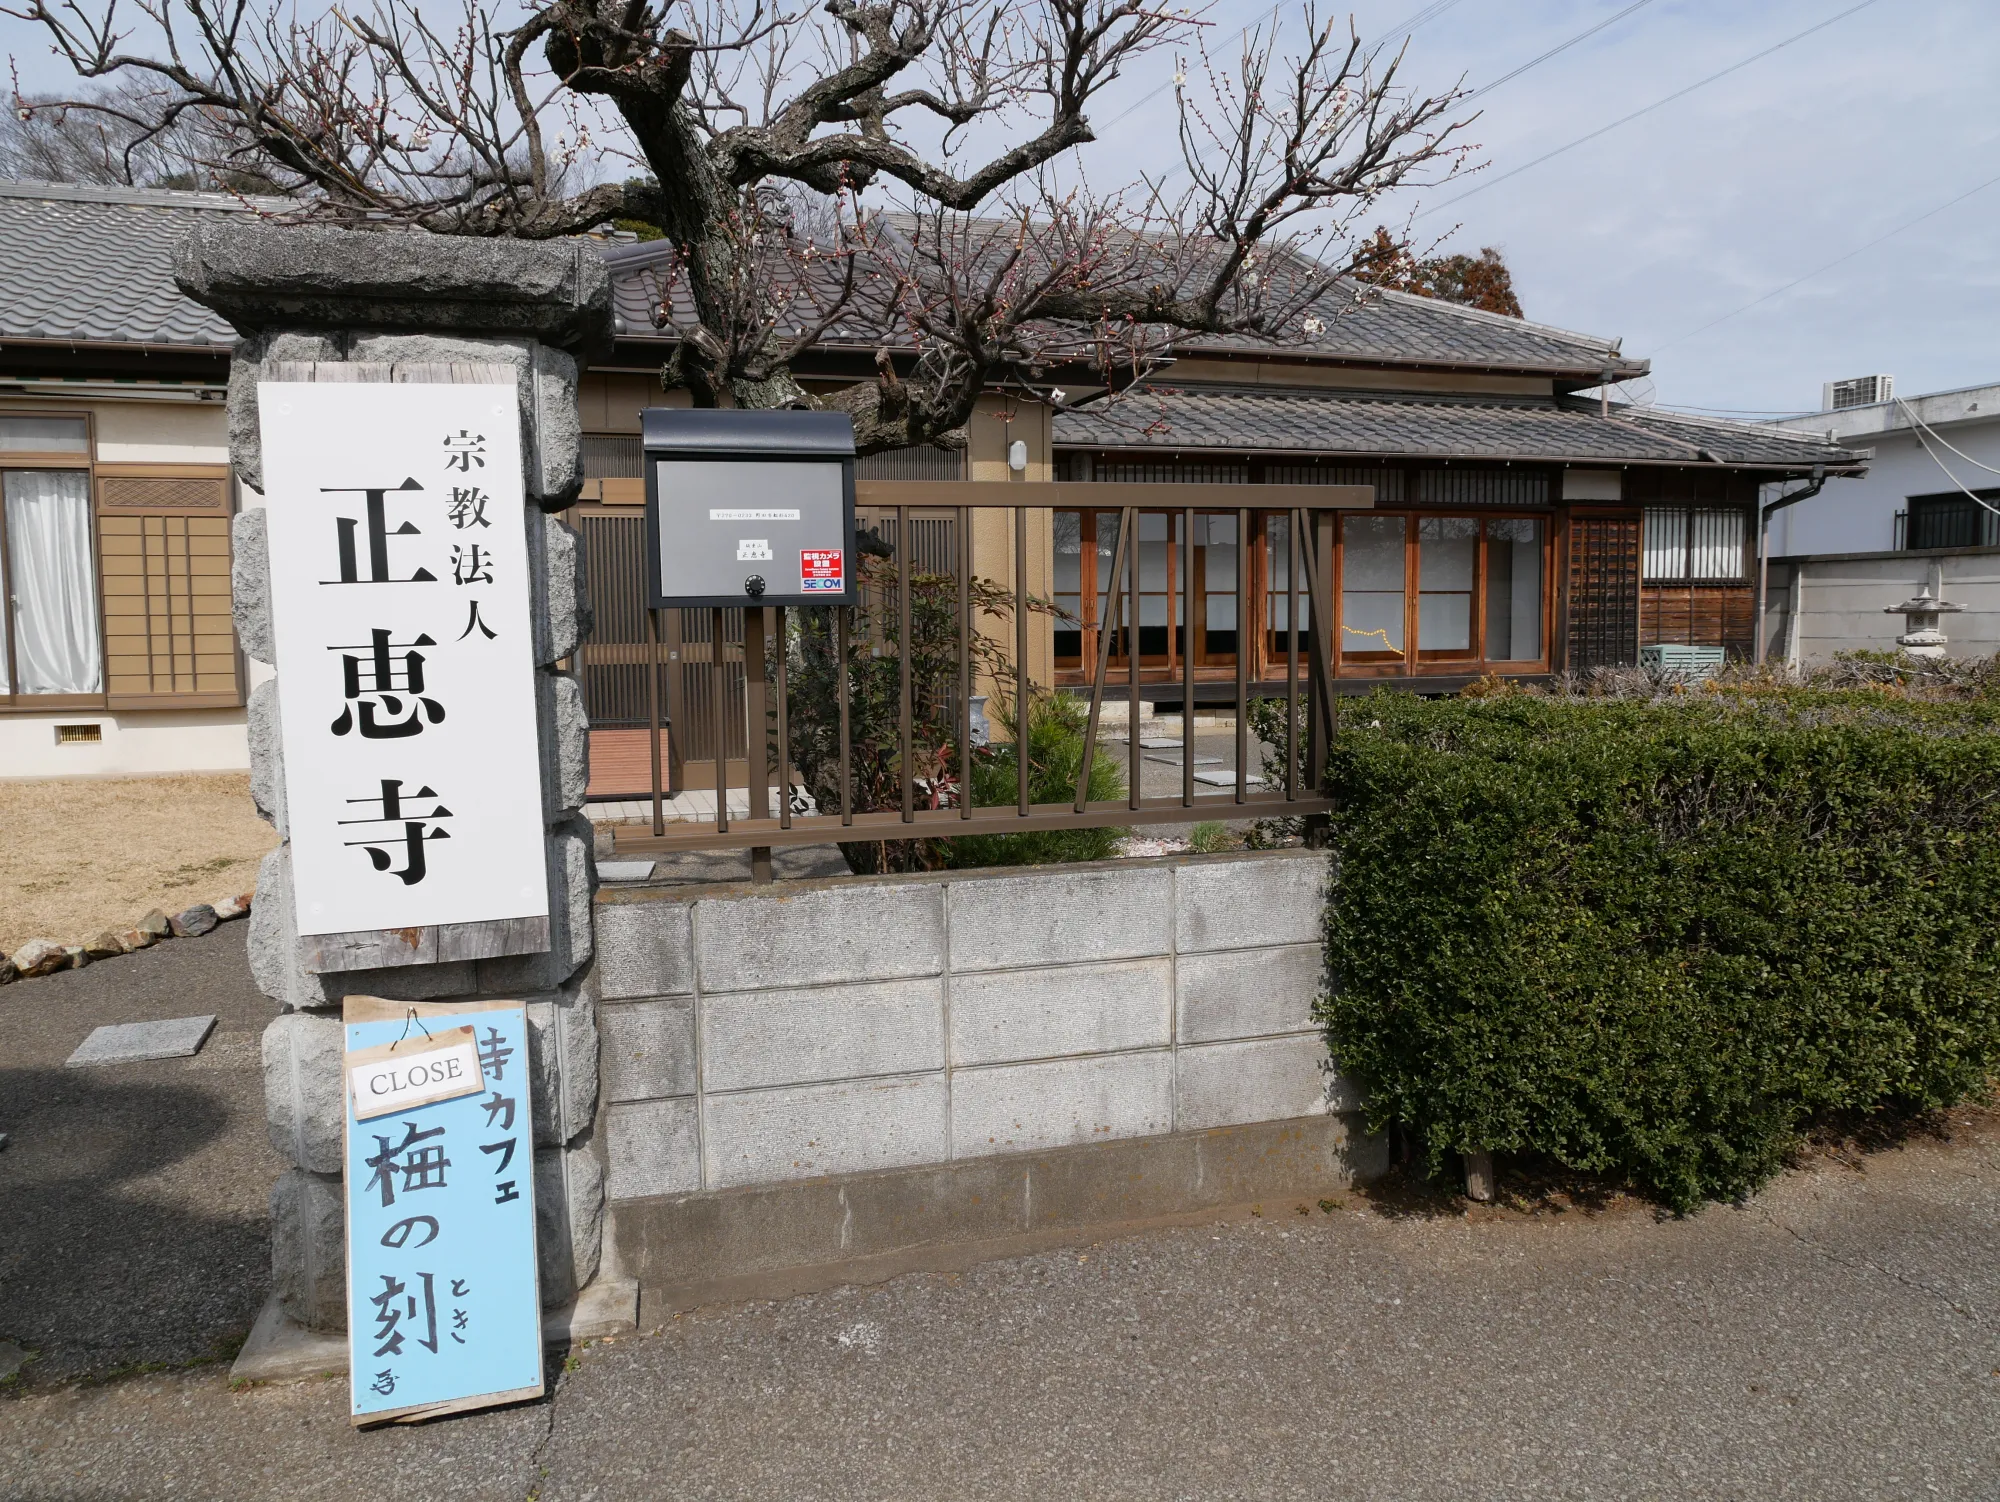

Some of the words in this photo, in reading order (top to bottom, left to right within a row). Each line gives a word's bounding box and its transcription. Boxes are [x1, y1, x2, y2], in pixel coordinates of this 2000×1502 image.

[443, 429, 498, 642] 宗教法人
[803, 578, 841, 588] SECOM
[318, 476, 454, 886] 正恵寺
[369, 1057, 463, 1096] CLOSE
[479, 1026, 520, 1205] 寺カフェ
[364, 1121, 452, 1358] 梅の刻
[450, 1277, 470, 1344] とき
